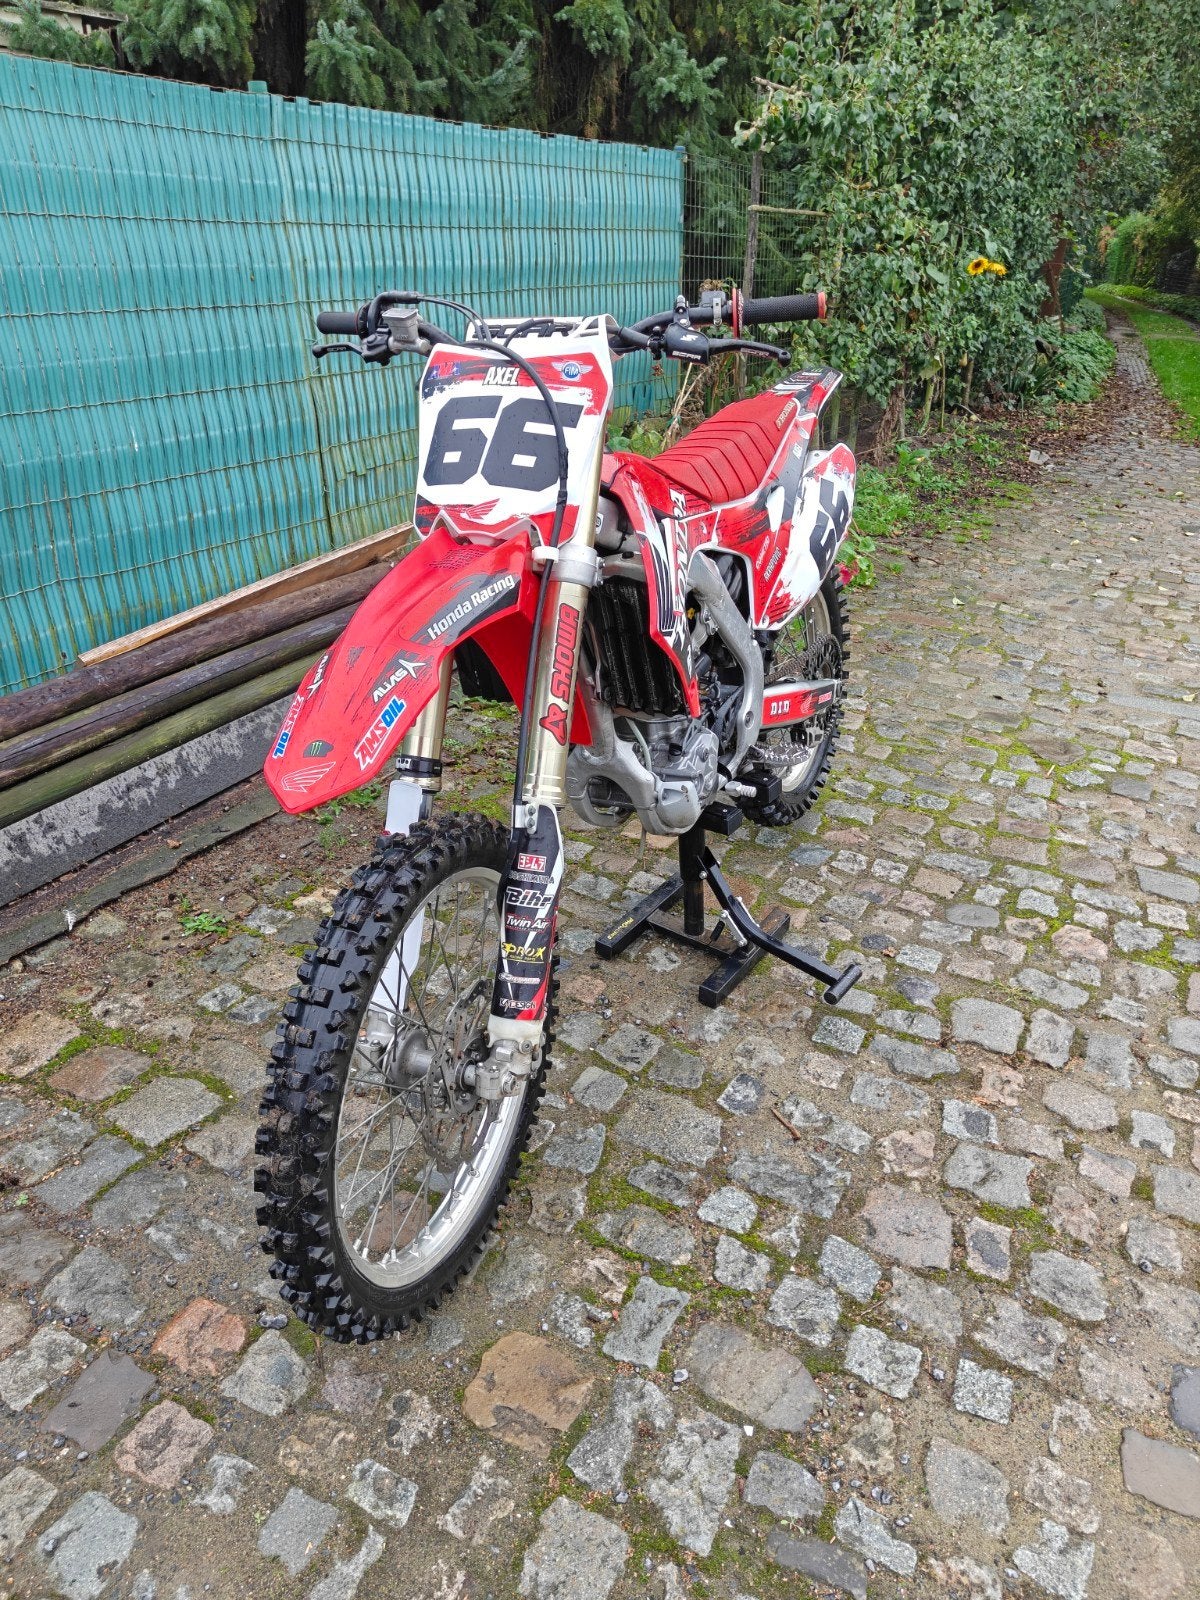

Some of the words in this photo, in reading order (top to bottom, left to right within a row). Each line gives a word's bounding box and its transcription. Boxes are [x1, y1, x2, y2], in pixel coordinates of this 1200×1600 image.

[672, 350, 702, 360] SCAR
[482, 366, 520, 386] AXEL
[565, 365, 580, 376] FIM
[423, 395, 584, 492] 66
[428, 601, 472, 640] Honda
[470, 574, 516, 607] Racing
[551, 603, 580, 704] SHOWA
[354, 695, 407, 771] AMSOIL
[518, 854, 546, 871] ヨシムラ
[506, 886, 554, 909] Bihr
[507, 915, 531, 928] Twin
[532, 919, 548, 929] Air
